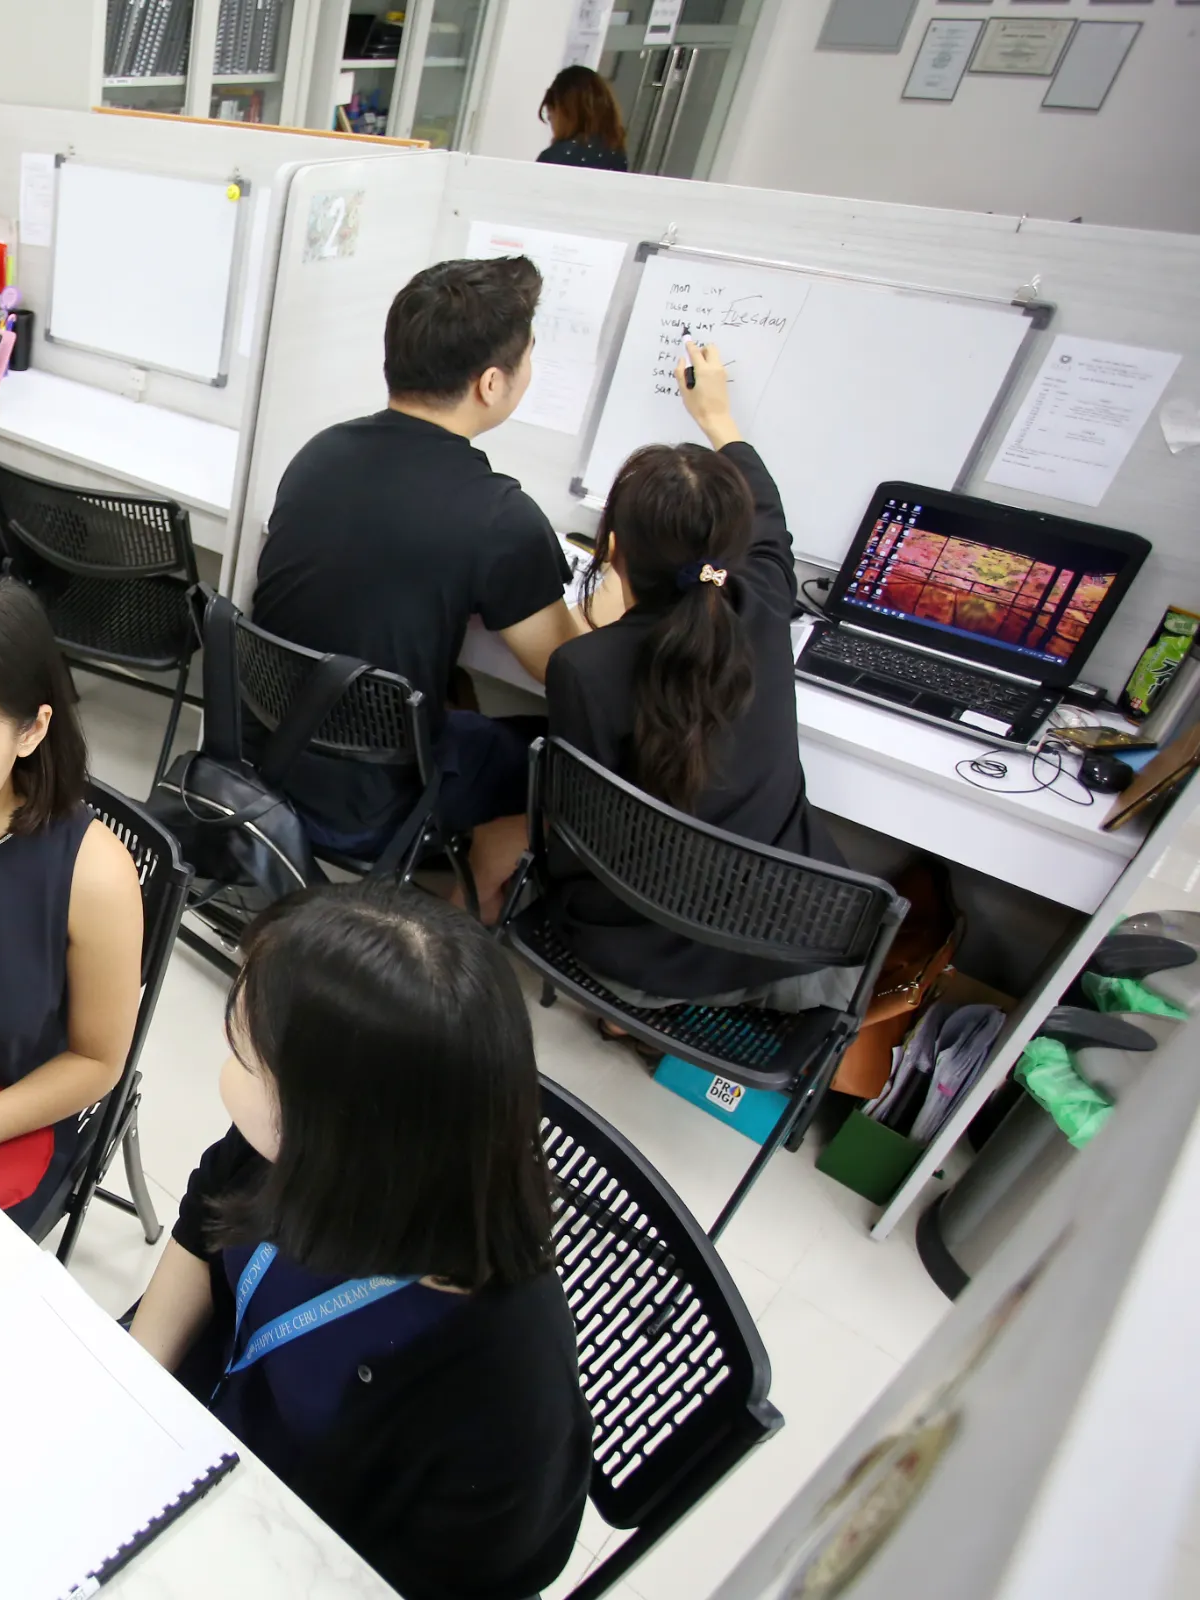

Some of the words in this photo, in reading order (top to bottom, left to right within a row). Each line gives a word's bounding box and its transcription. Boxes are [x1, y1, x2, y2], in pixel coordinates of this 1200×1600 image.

[323, 196, 345, 256] 2
[721, 295, 786, 333] Tuesday
[710, 1086, 735, 1105] DIGI
[253, 1329, 275, 1353] HAPPY
[274, 1322, 293, 1340] LIFE
[292, 1308, 318, 1330] CEBU
[319, 1283, 370, 1318] ACADEMY
